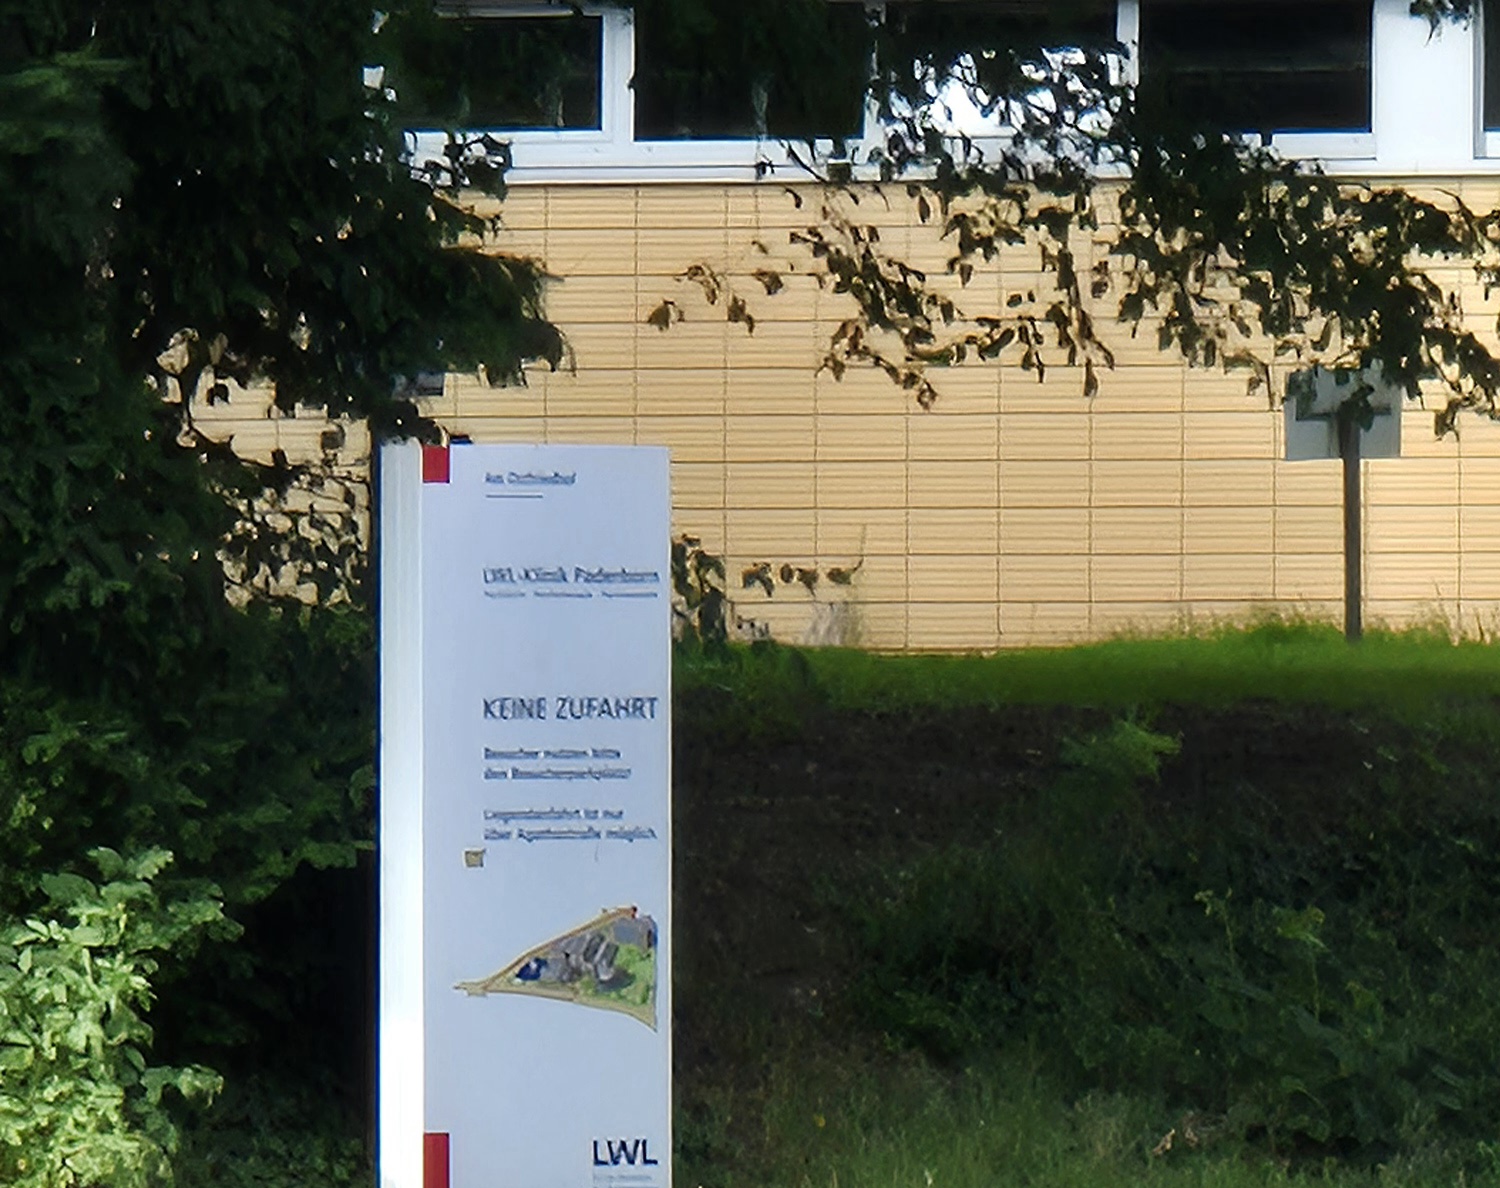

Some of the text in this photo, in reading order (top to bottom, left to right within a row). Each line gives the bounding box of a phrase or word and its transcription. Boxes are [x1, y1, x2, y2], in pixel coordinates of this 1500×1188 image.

[484, 697, 659, 721] KEINE ZUFAHRT
[593, 1139, 659, 1166] LWL
